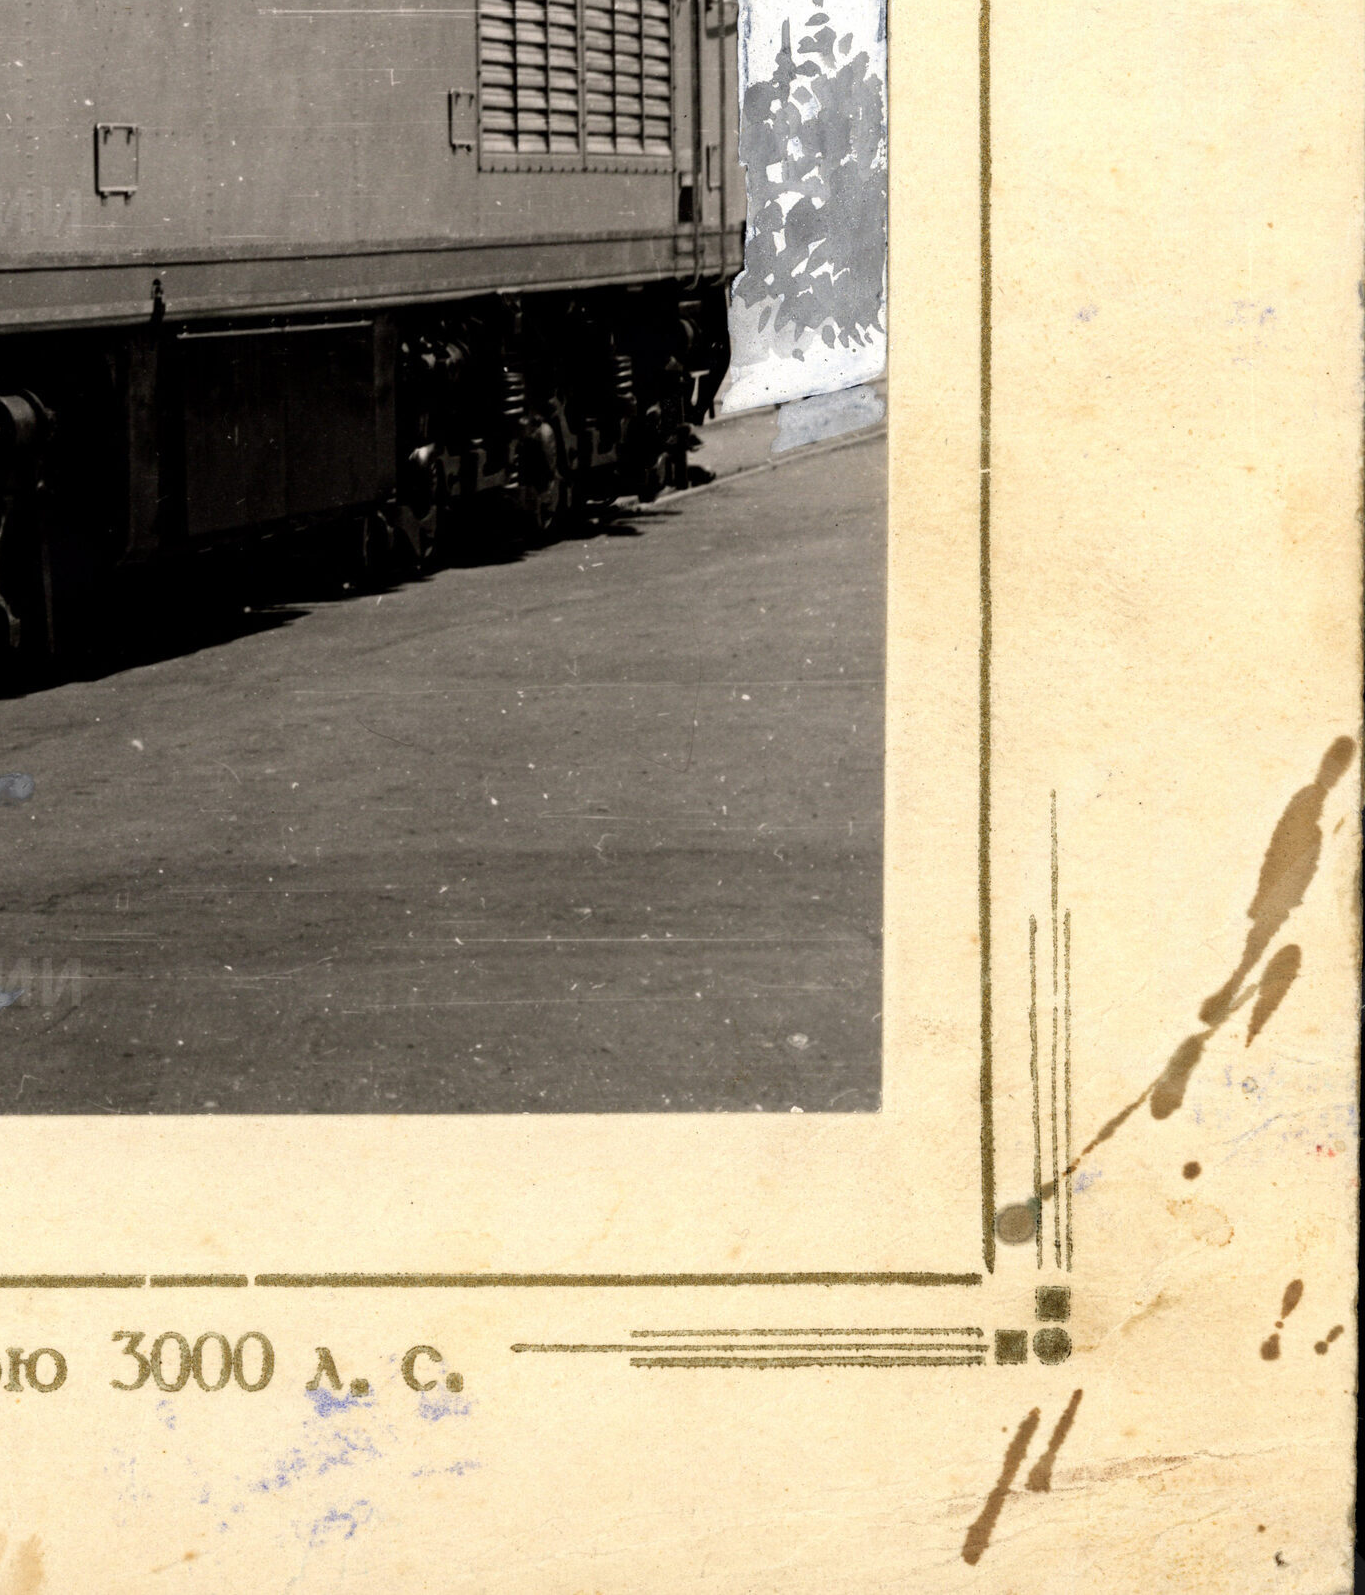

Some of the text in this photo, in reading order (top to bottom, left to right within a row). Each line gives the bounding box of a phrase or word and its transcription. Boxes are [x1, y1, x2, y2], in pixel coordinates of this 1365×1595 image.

[111, 1331, 275, 1393] 3000
[305, 1346, 371, 1397] л.
[400, 1345, 464, 1393] с.
